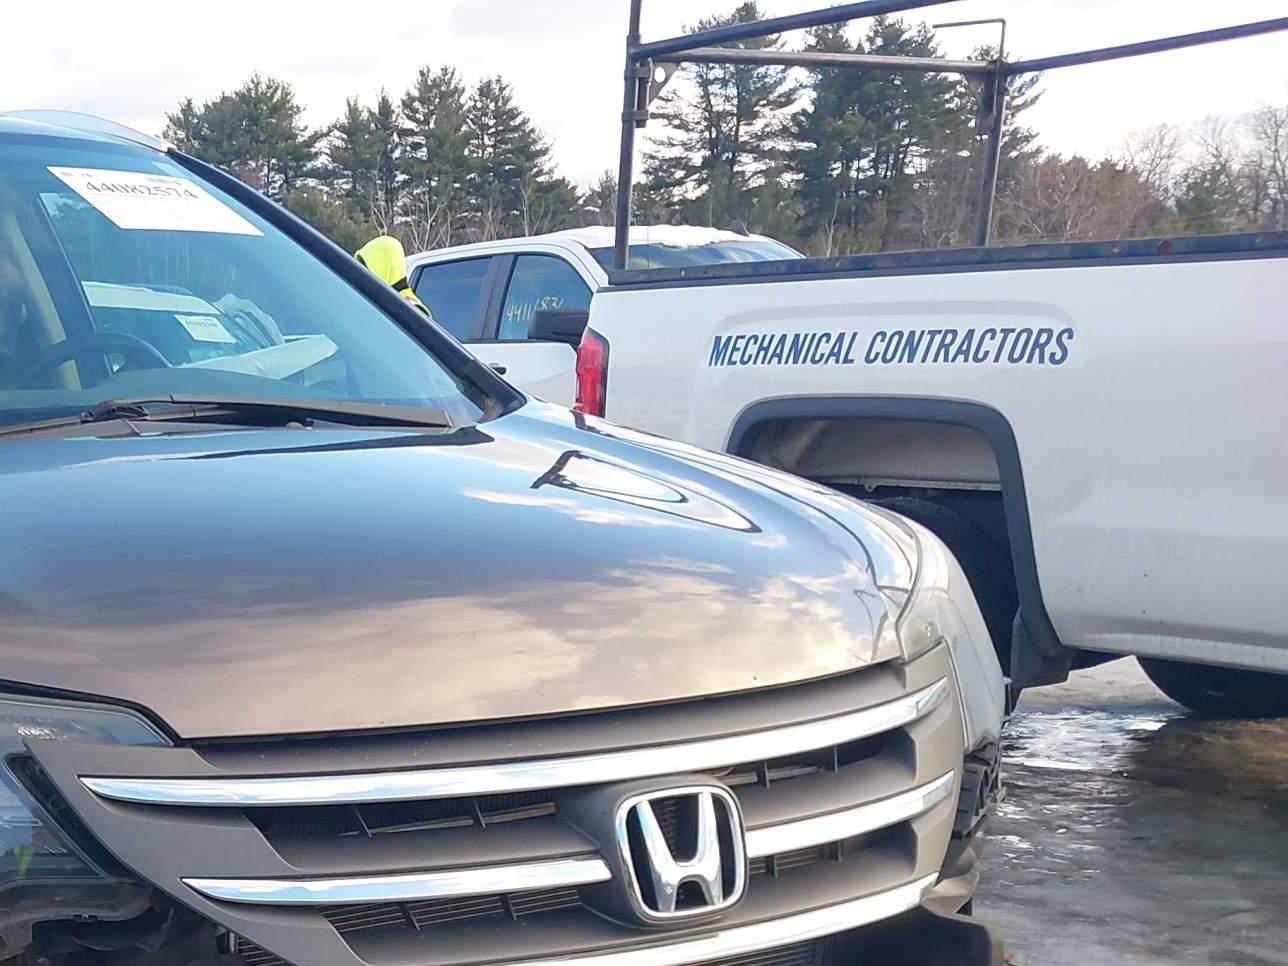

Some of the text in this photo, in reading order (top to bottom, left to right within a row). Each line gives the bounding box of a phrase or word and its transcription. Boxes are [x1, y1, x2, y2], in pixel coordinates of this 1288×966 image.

[86, 181, 199, 199] 44082574
[708, 327, 1074, 367] MECHANICAL CONTRACTORS
